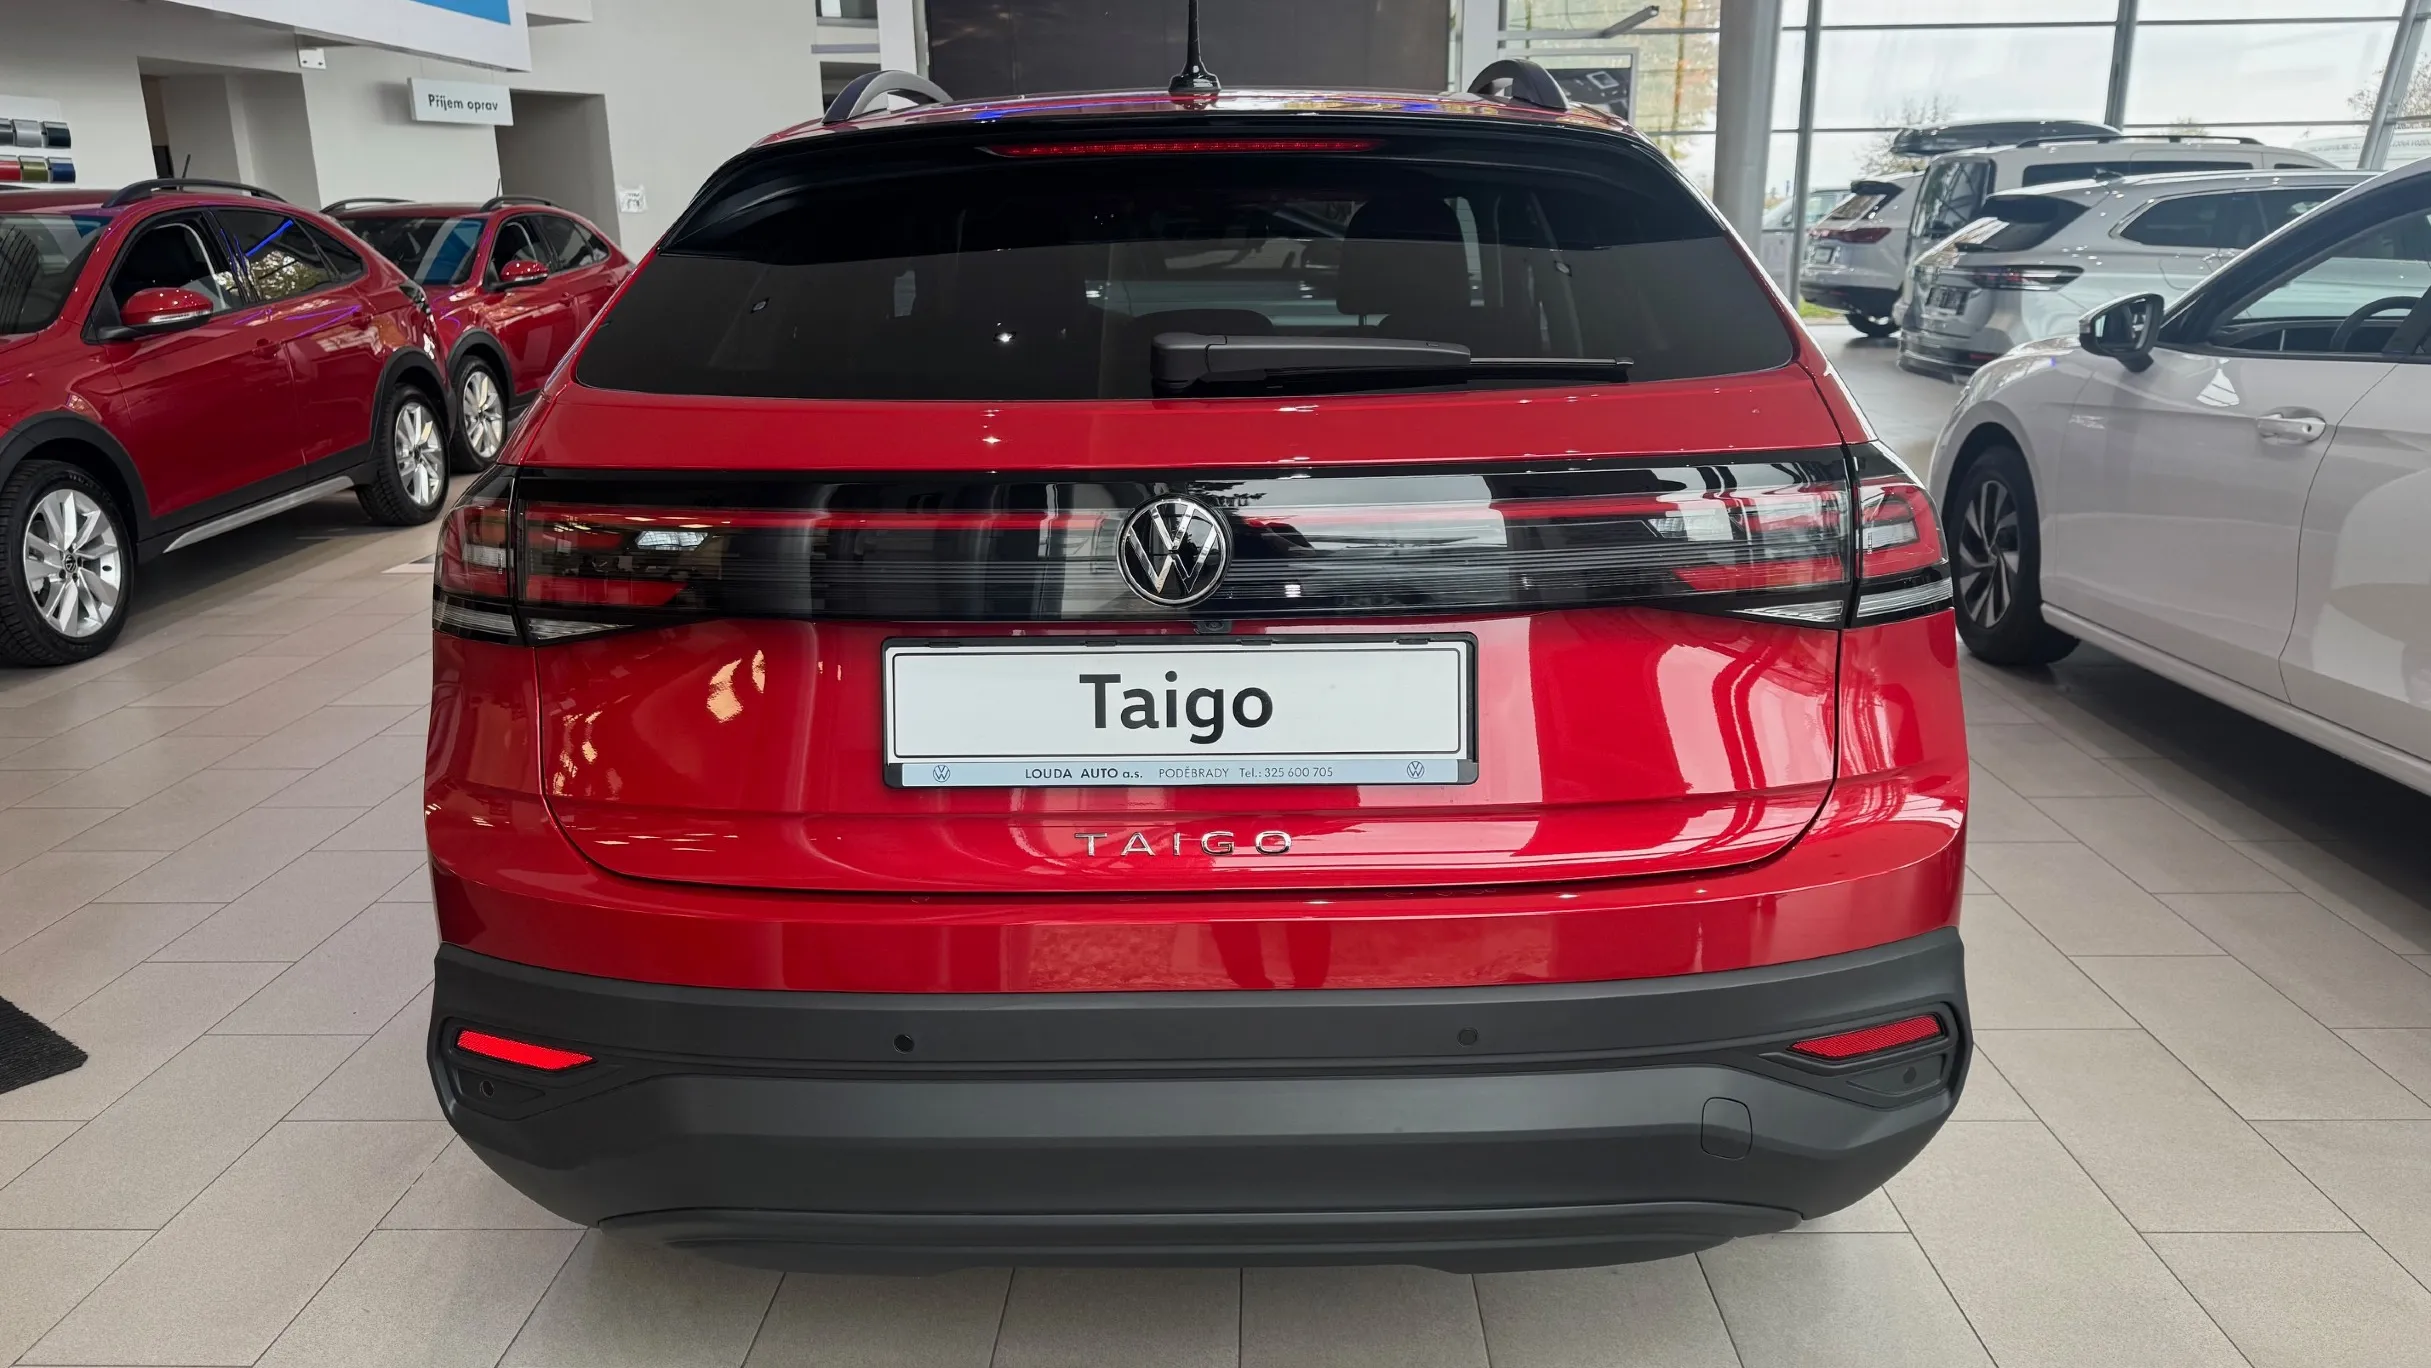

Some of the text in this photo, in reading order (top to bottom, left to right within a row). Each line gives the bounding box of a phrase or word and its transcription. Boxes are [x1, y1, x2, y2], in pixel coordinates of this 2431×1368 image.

[428, 93, 499, 113] Příjem oprav
[1079, 670, 1274, 745] Taigo
[1025, 766, 1333, 779] LOUDA AUTO a.s. PODĚBRADY Tel.: 325 600 705
[1074, 831, 1293, 857] TAIGO
